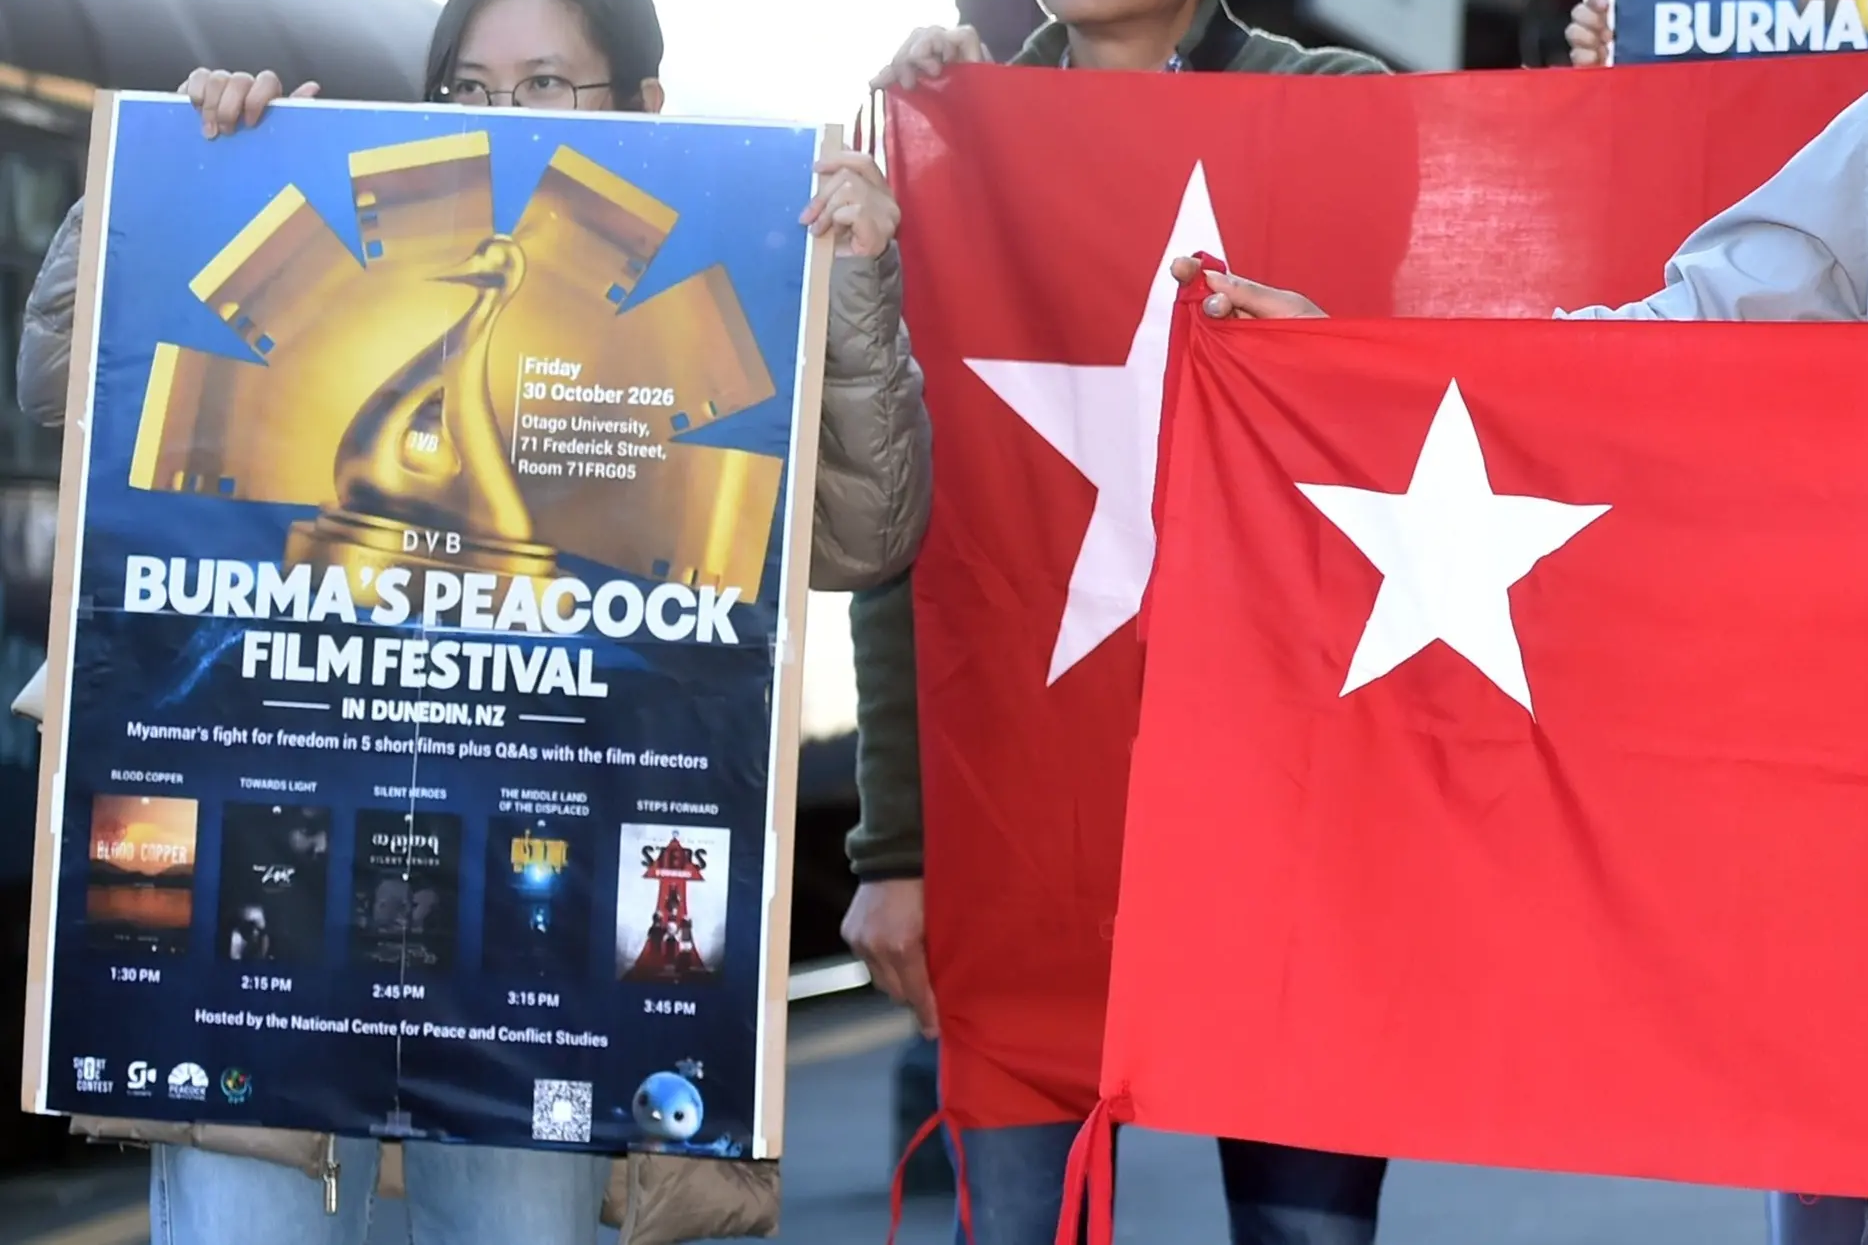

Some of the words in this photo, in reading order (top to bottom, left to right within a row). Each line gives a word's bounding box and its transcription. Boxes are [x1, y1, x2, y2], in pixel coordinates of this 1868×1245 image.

[524, 357, 582, 381] Friday
[523, 383, 545, 400] 30
[551, 384, 624, 404] October
[627, 388, 675, 406] 2026
[521, 414, 566, 434] Otago
[571, 416, 651, 437] University,
[520, 437, 538, 452] 71
[543, 438, 613, 456] Frederick
[617, 441, 667, 460] Street,
[518, 459, 562, 476] Room
[567, 461, 637, 479] 71FRG05
[124, 554, 410, 627] BURMA'S
[424, 570, 742, 643] PEACOCK
[241, 630, 367, 686] FILM
[371, 638, 609, 698] FESTIVAL
[342, 697, 364, 720] IN
[371, 700, 472, 727] DUNEDIN,
[475, 704, 506, 727] NZ
[127, 722, 209, 742] Myanmar's
[213, 725, 248, 747] fight
[251, 727, 274, 745] for
[277, 730, 339, 750] freedom
[343, 733, 357, 750] in
[361, 735, 372, 751] 5
[375, 736, 413, 753] short
[417, 738, 455, 755] films
[459, 740, 491, 760] plus
[495, 742, 538, 761] Q&As
[541, 744, 574, 762] with
[577, 746, 603, 763] the
[606, 747, 636, 765] film
[639, 750, 709, 770] directors
[111, 769, 144, 784] BLOOD
[145, 770, 184, 785] COPPER
[240, 777, 286, 793] TOWARDS
[288, 779, 318, 794] LIGHT
[373, 784, 407, 799] SILENT
[500, 788, 519, 801] THE
[521, 789, 558, 803] MIDDLE
[560, 791, 588, 804] LAND
[499, 801, 513, 813] OF
[514, 801, 533, 814] THE
[535, 803, 590, 817] DISPLACED
[636, 800, 667, 814] STEPS
[670, 801, 719, 816] FORWARD
[110, 966, 137, 982] 1:30
[139, 969, 161, 984] PM
[241, 975, 268, 991] 2:15
[271, 977, 292, 993] PM
[372, 983, 400, 999] 2:45
[403, 985, 425, 1000] PM
[508, 991, 536, 1006] 3:15
[538, 993, 560, 1008] PM
[644, 999, 672, 1014] 3:45
[674, 1001, 696, 1016] PM
[195, 1008, 244, 1027] Hosted
[246, 1011, 263, 1031] by
[266, 1012, 288, 1029] the
[291, 1015, 349, 1033] National
[352, 1018, 398, 1036] Centre
[400, 1022, 421, 1038] for
[423, 1022, 466, 1040] Peace
[469, 1025, 495, 1041] and
[498, 1026, 553, 1044] Conflict
[556, 1030, 608, 1048] Studies
[76, 1080, 114, 1094] CONTEST
